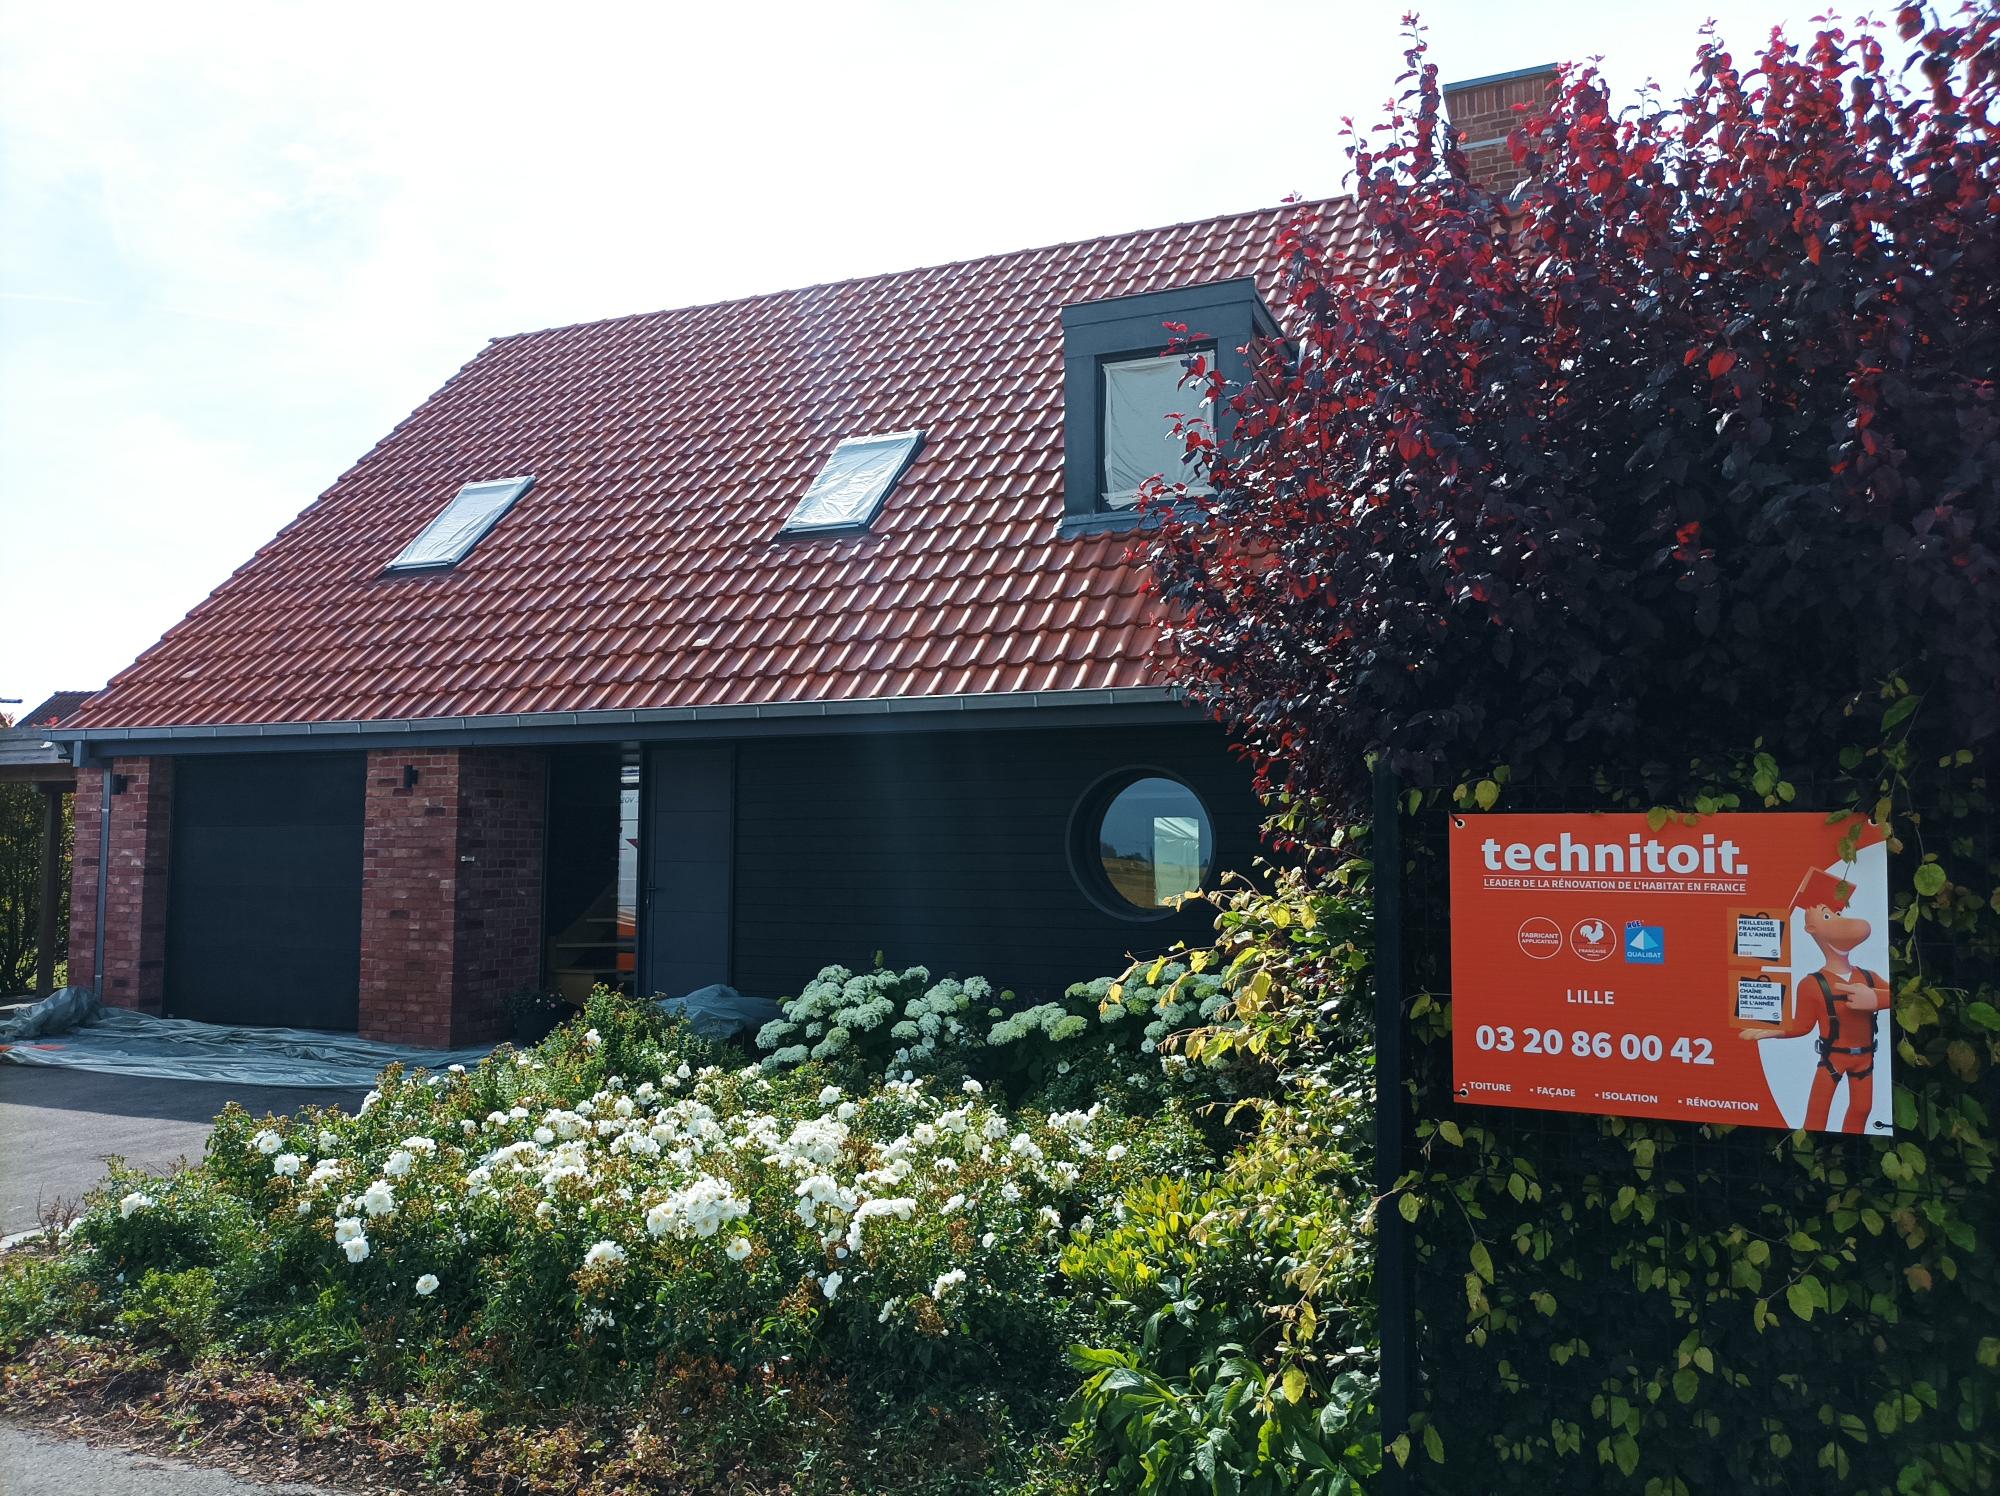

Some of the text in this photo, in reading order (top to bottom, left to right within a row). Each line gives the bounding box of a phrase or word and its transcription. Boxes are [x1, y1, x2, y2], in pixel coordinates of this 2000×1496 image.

[1484, 877, 1746, 892] LEADER DE LA RÉNOVATION DE L'HABITAT EN FRANCE
[1626, 920, 1641, 928] RGE
[1567, 989, 1615, 1005] LILLE
[1475, 1025, 1715, 1065] 03 20 86 00 42
[1470, 1081, 1511, 1092] TOITURE
[1536, 1086, 1576, 1098] FAÇADE
[1602, 1091, 1658, 1104] ISOLATION
[1686, 1096, 1759, 1111] RÉNOVATION
